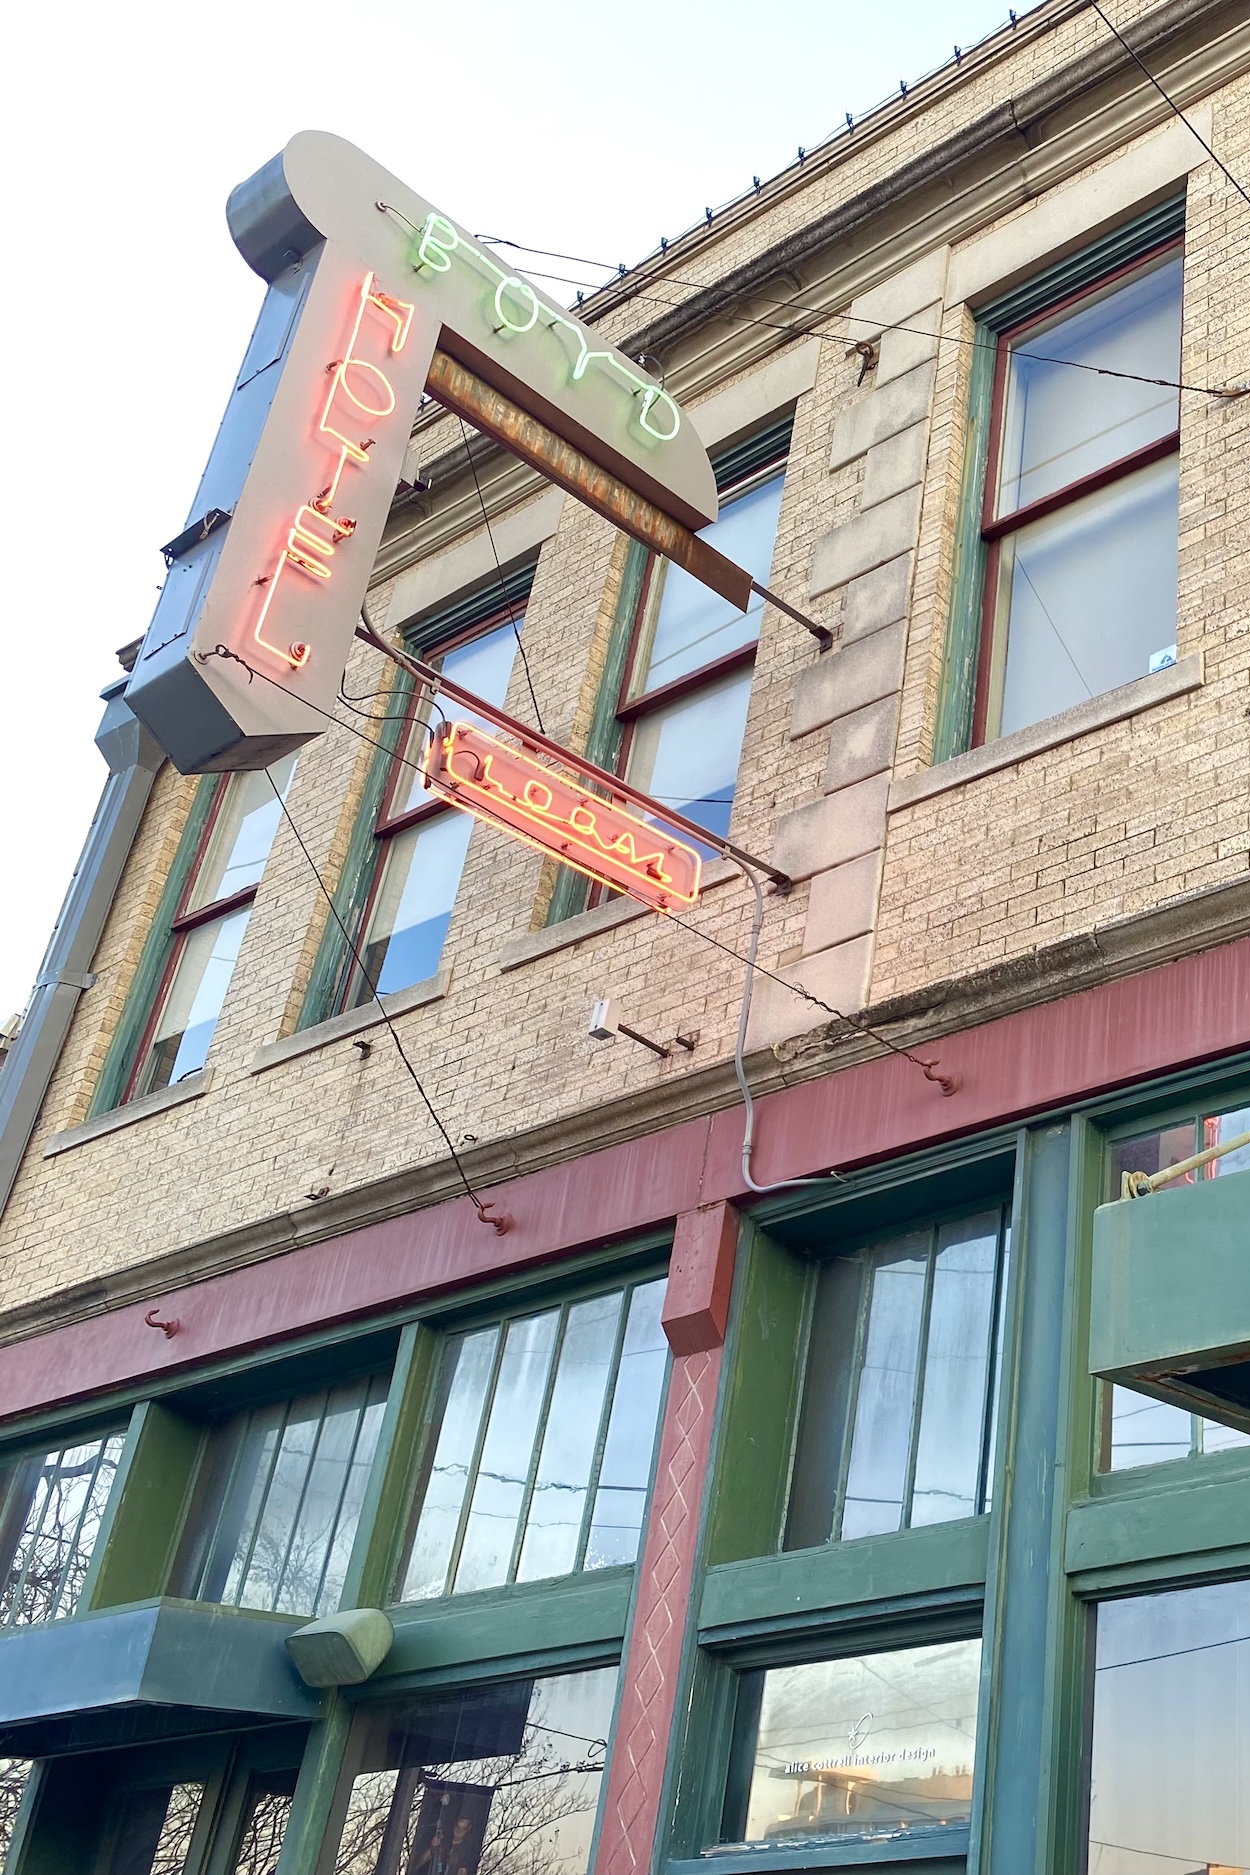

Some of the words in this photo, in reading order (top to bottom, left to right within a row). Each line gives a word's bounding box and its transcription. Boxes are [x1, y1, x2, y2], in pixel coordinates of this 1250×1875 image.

[419, 212, 681, 441] BOYD
[255, 271, 415, 668] HOTEL
[784, 1762, 810, 1775] alice
[811, 1755, 853, 1771] cottrell
[853, 1751, 896, 1767] interior
[897, 1747, 936, 1762] design
